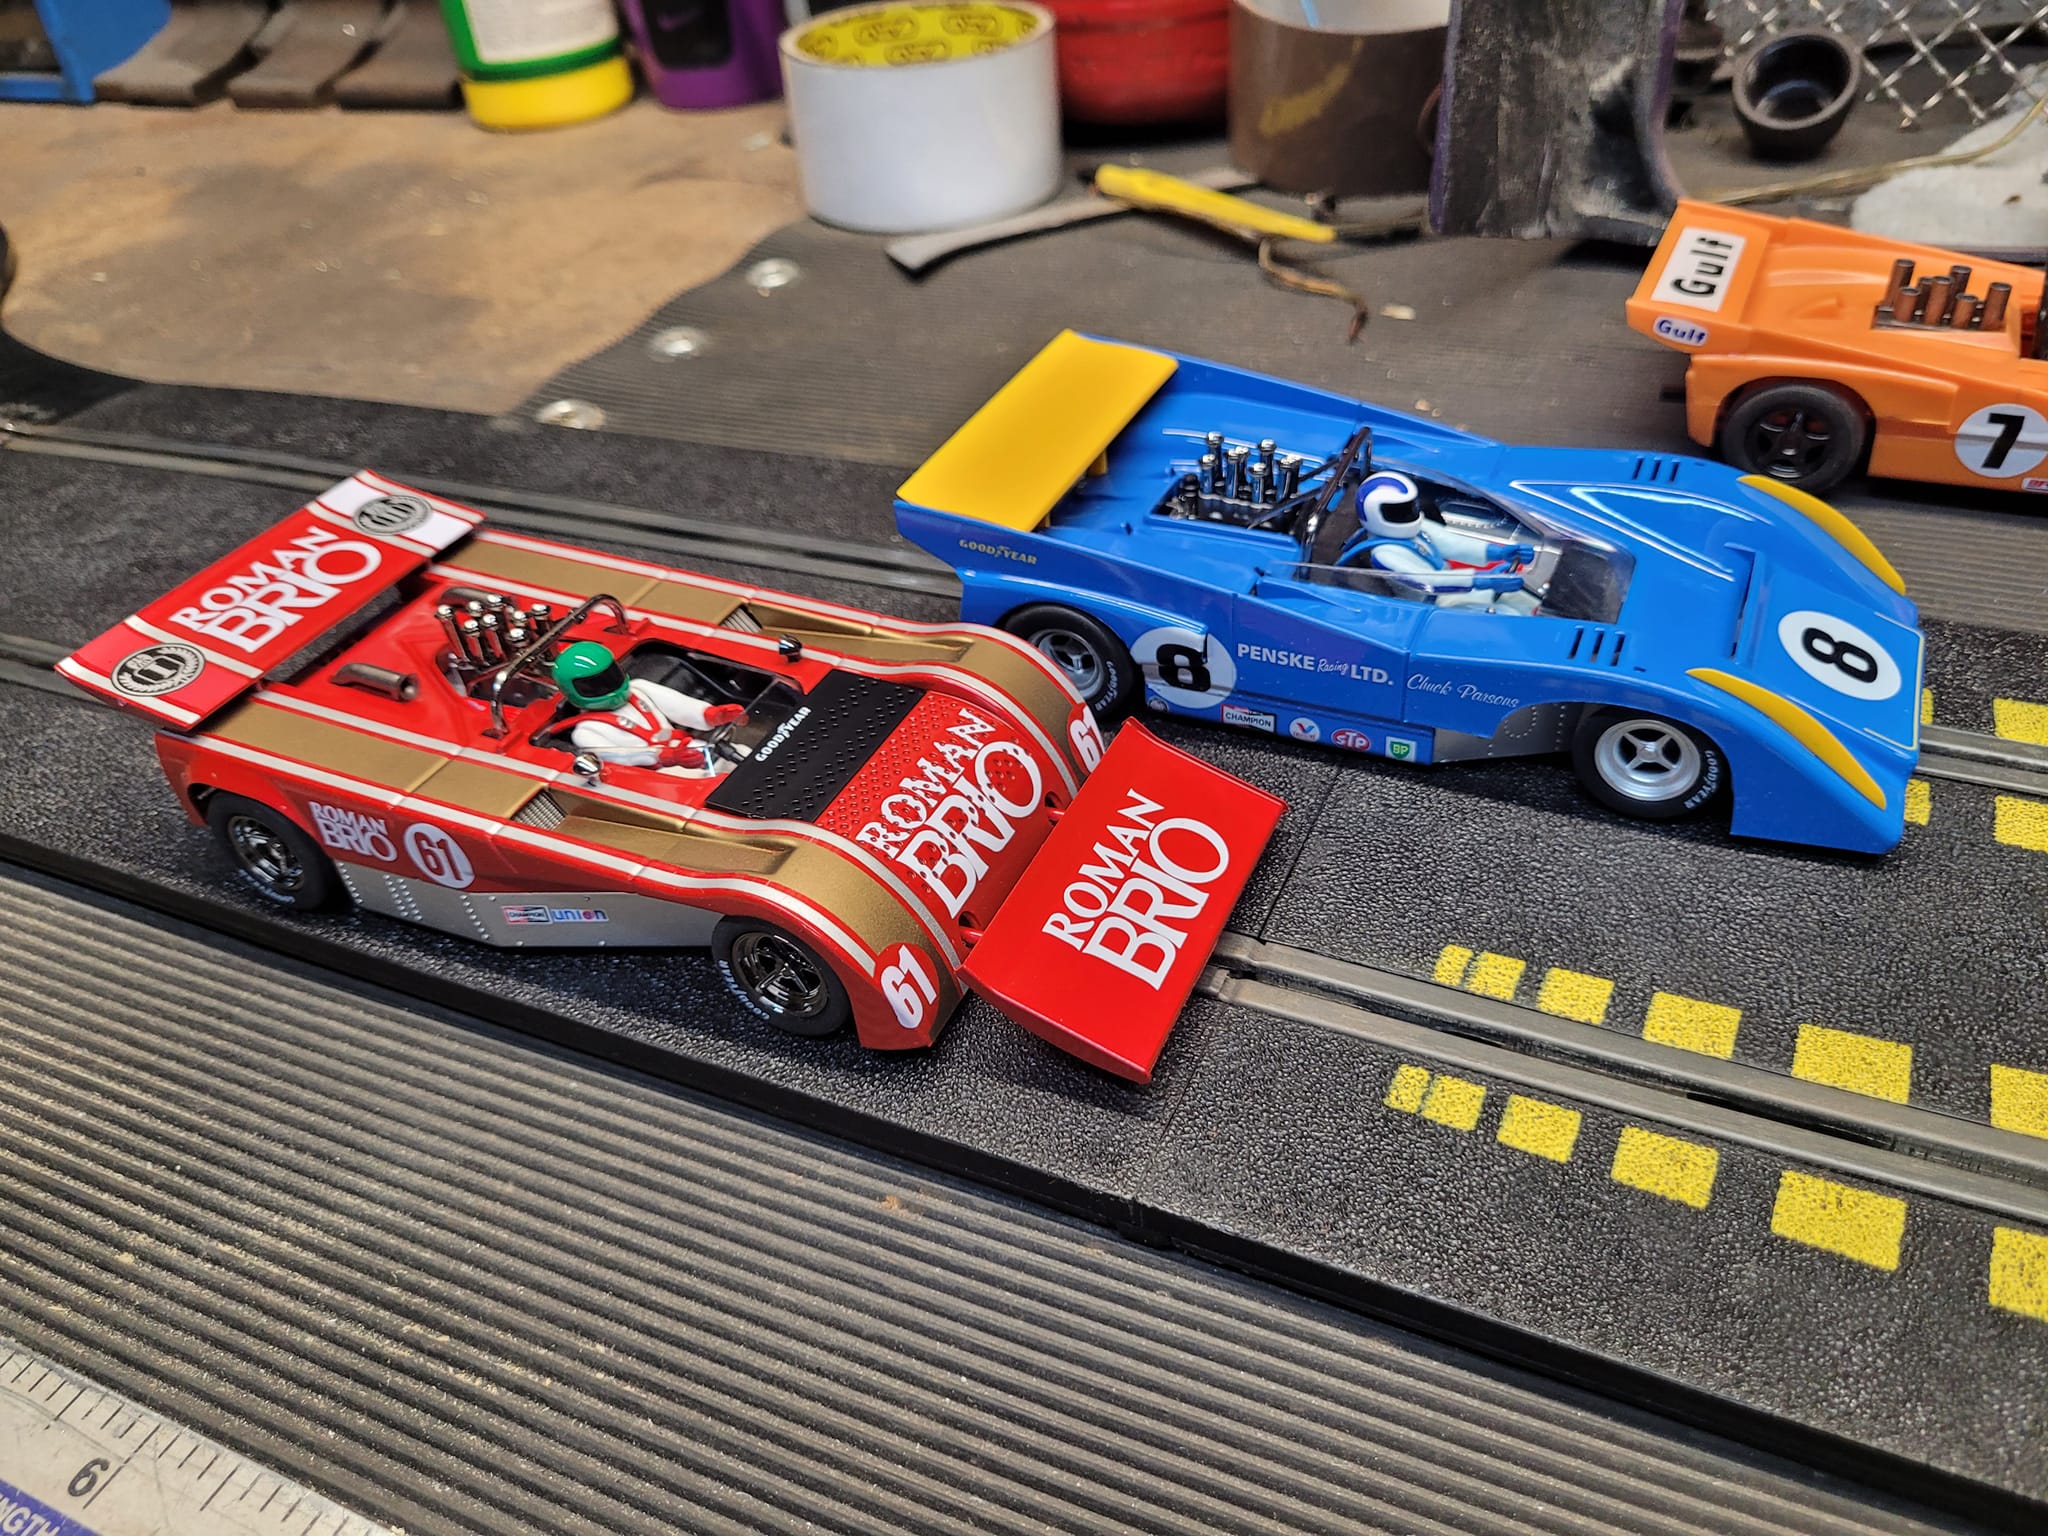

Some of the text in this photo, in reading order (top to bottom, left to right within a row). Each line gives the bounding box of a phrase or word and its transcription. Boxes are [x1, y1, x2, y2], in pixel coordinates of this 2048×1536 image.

[1671, 237, 1733, 297] Gulf
[1657, 319, 1706, 343] Gulf
[1981, 412, 2026, 469] 7
[168, 525, 341, 632] ROMAN
[958, 538, 1037, 565] GOODYEAR
[198, 540, 382, 653] BRIO
[1156, 643, 1212, 692] 8
[1237, 642, 1394, 686] PENSKE Racing LTD.
[1803, 626, 1878, 684] 8
[1406, 673, 1520, 709] Chuck Parsons
[754, 706, 812, 762] GOODYEAR
[1069, 705, 1106, 773] 61
[1225, 712, 1272, 727] CHAMPION
[1336, 731, 1367, 749] STP
[855, 707, 997, 860] ROMAN
[1683, 749, 1719, 809] GOODYEAR
[308, 800, 389, 836] ROMAN
[317, 820, 398, 862] BRIO
[896, 740, 1043, 919] BRIO
[413, 831, 464, 882] 61
[1041, 788, 1166, 952] ROMAN
[1081, 817, 1230, 991] BRIO
[880, 943, 938, 1030] 61
[67, 1457, 110, 1498] 6
